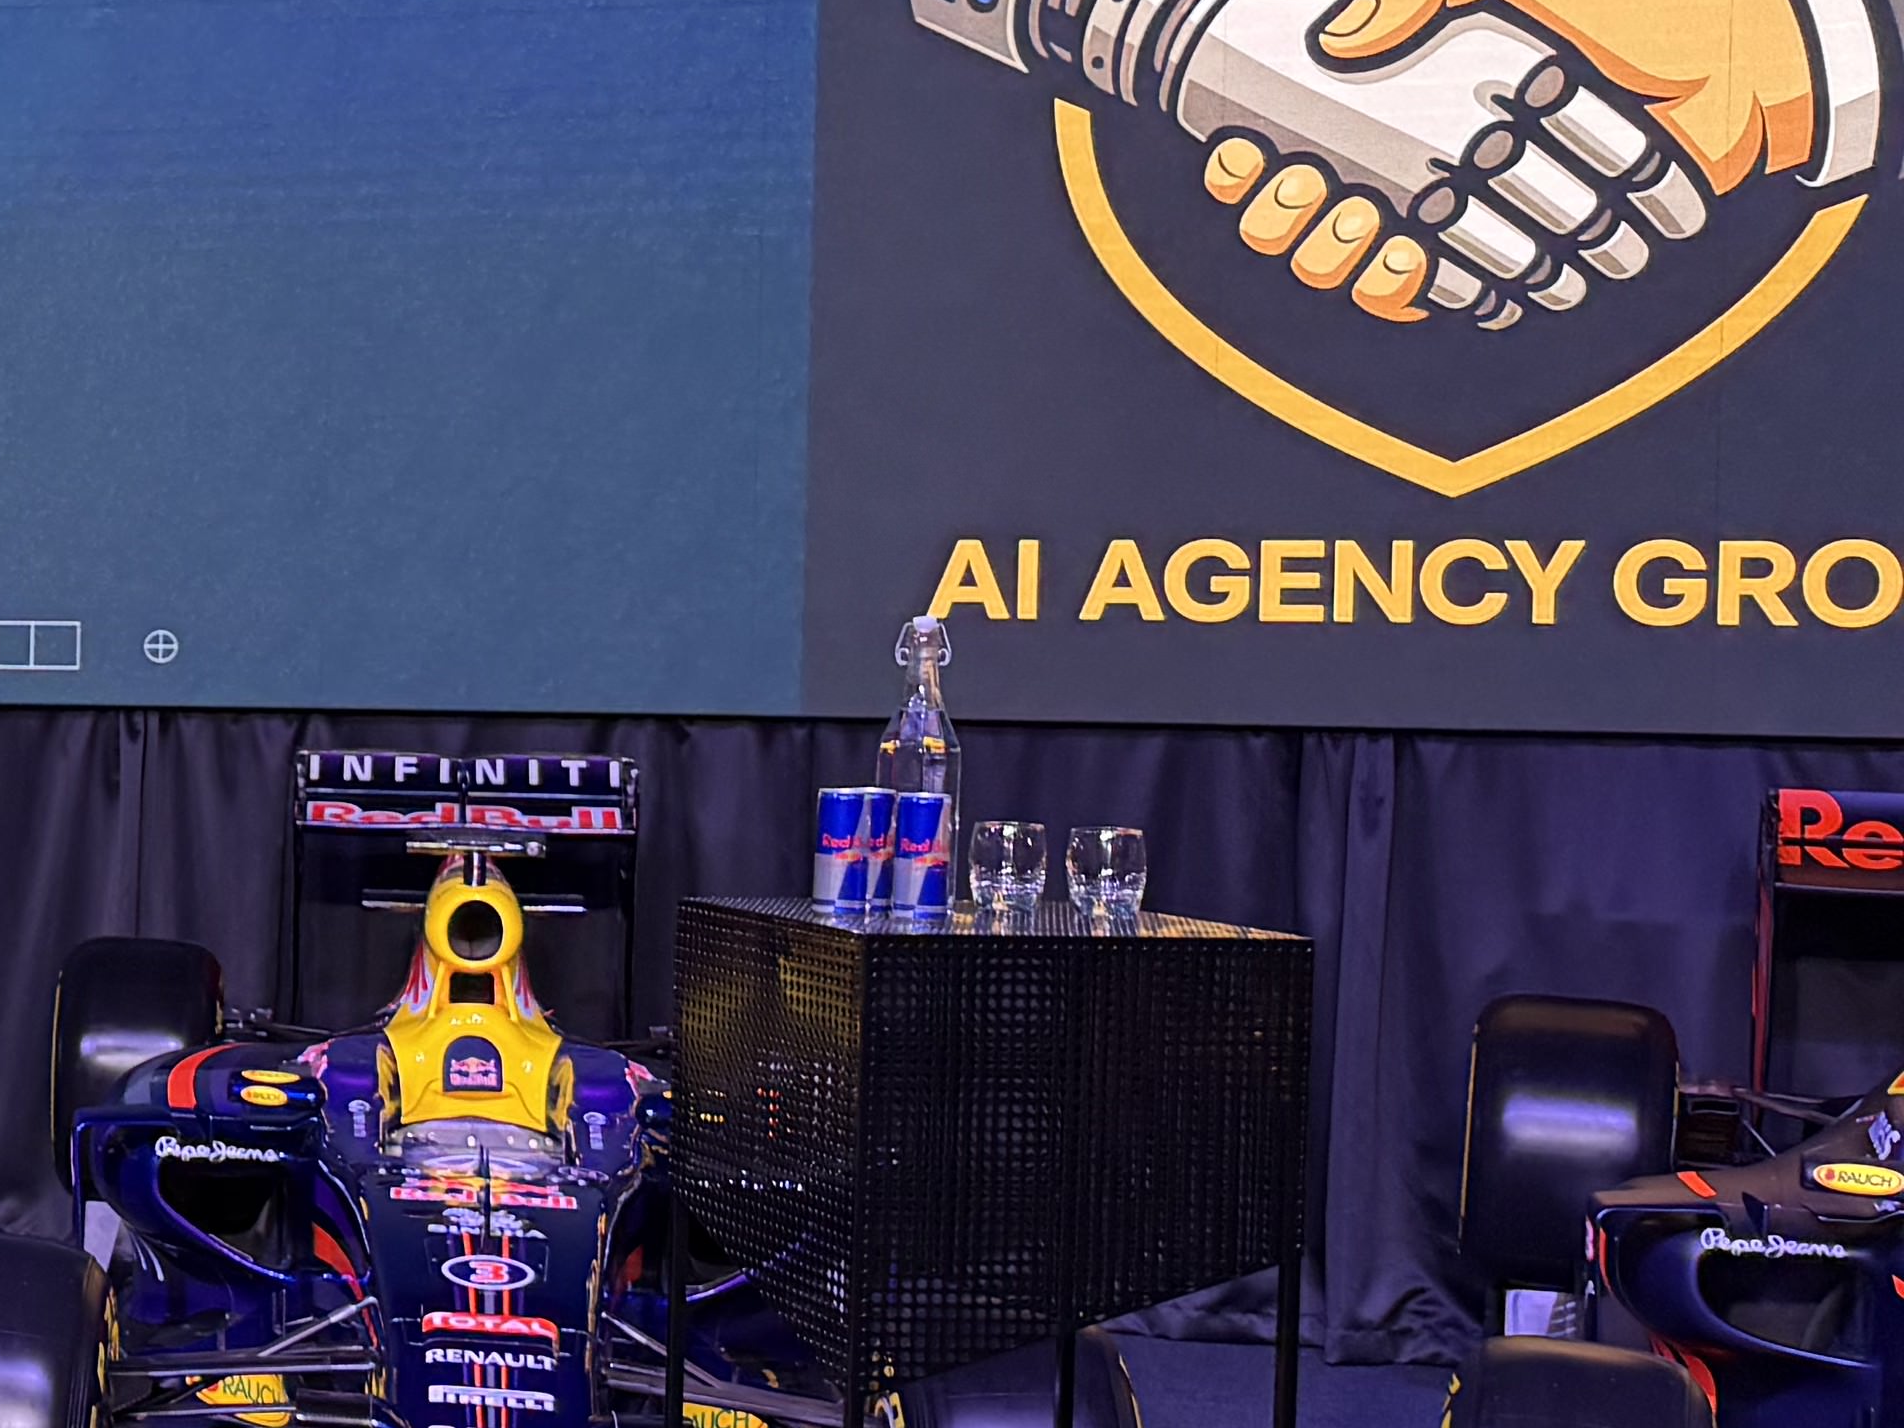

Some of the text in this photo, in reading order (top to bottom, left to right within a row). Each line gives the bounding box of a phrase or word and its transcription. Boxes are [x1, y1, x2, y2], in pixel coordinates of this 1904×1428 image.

[928, 538, 1903, 629] AI AGENCY GRO
[308, 753, 622, 788] INFINITI
[306, 800, 622, 830] Red Bull
[155, 1136, 280, 1163] Pepe Jeans
[1837, 1171, 1893, 1187] RAUCH
[1700, 1227, 1847, 1259] Pepe Jeans
[468, 1260, 510, 1284] 3
[425, 1348, 558, 1372] RENAULT
